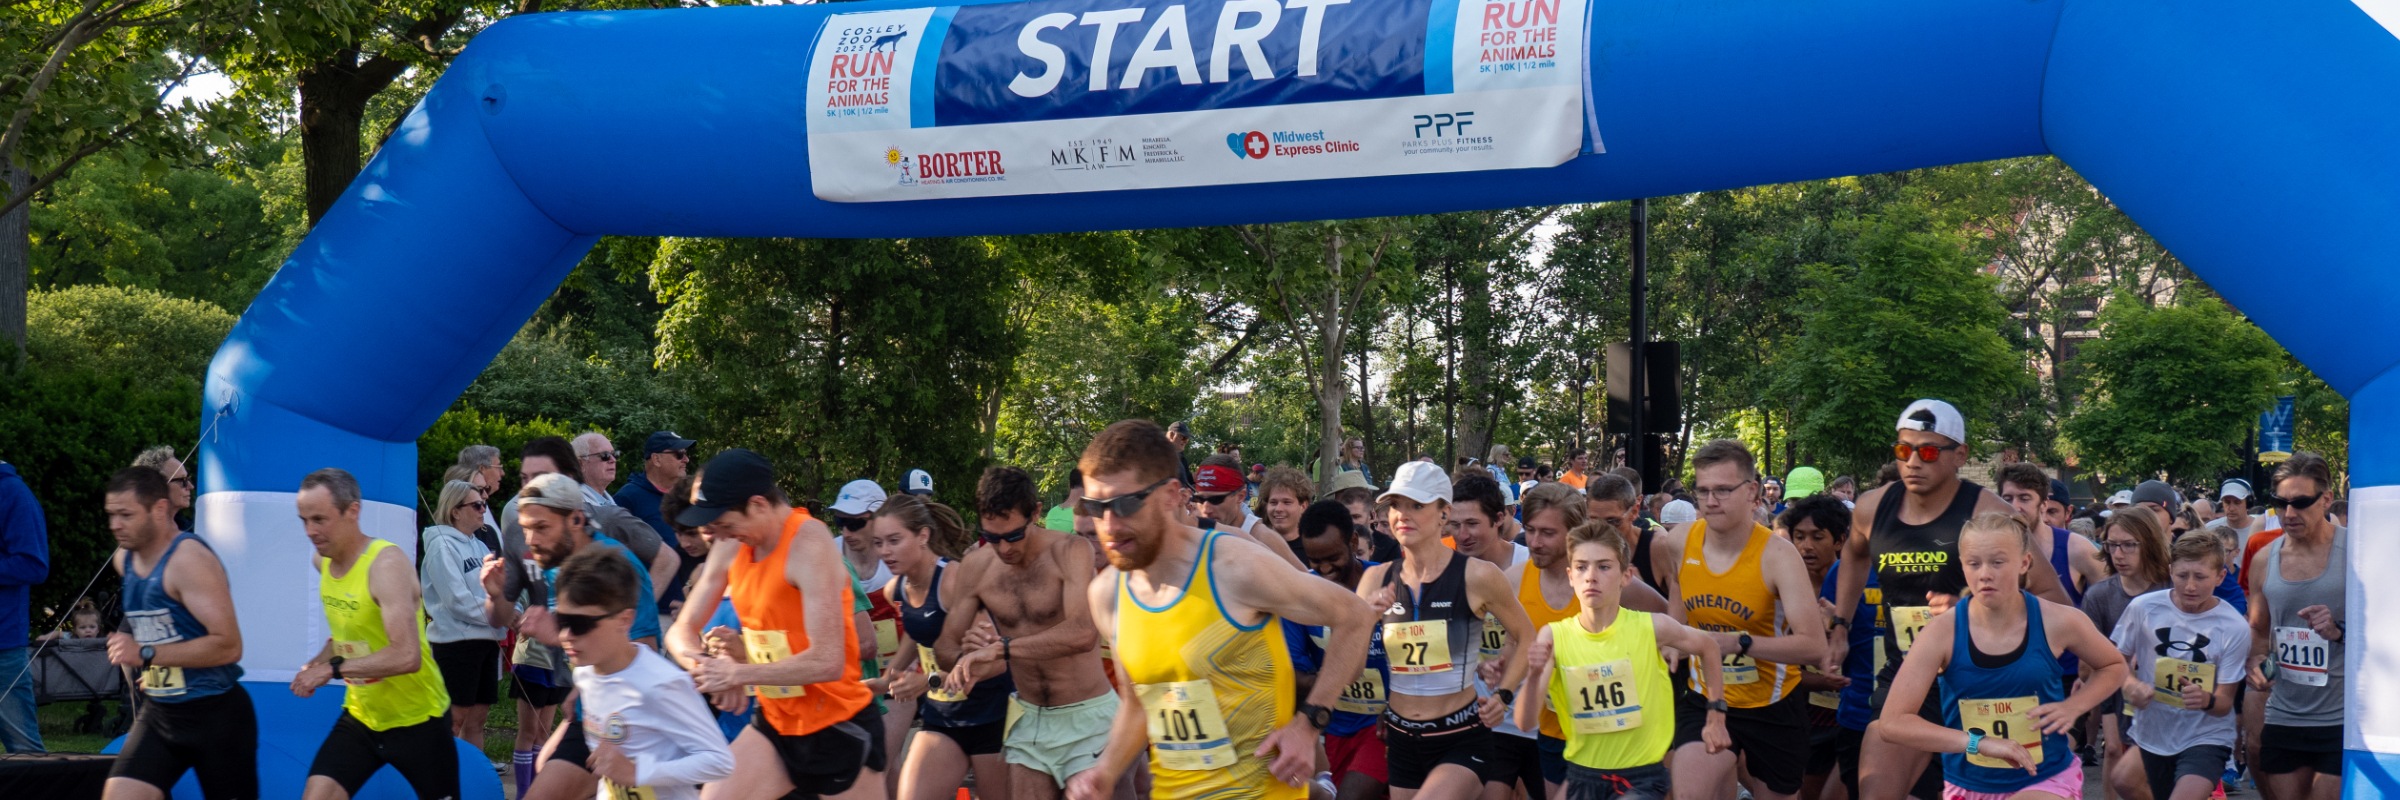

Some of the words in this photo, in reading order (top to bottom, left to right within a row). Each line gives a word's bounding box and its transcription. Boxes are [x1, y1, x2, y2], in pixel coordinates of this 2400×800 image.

[1482, 0, 1560, 30] RUN
[843, 24, 905, 36] COSLEY
[1481, 30, 1516, 46] FOR
[1523, 27, 1556, 43] THE
[838, 35, 873, 45] ZOO
[835, 45, 864, 53] 2025
[1008, 0, 1351, 98] START
[1480, 43, 1555, 63] ANIMALS
[830, 51, 895, 79] RUN
[1480, 64, 1490, 72] 5K
[1500, 63, 1515, 71] 10K
[1523, 61, 1536, 69] 1/2
[1539, 60, 1555, 68] mile
[828, 79, 857, 93] FOR
[862, 77, 890, 91] THE
[827, 92, 888, 108] ANIMALS
[827, 109, 836, 117] 5K
[843, 108, 856, 116] 10K
[862, 107, 873, 115] 1/2
[874, 106, 889, 114] mile
[1413, 111, 1474, 138] PPF
[1272, 129, 1325, 143] Midwest
[1402, 140, 1428, 148] PARKS
[1431, 138, 1453, 146] PLUS
[1456, 136, 1493, 144] FITNESS
[1275, 143, 1322, 158] Express
[1325, 140, 1359, 153] Clinic
[917, 150, 1005, 178] BORTER
[2264, 404, 2291, 428] W
[1888, 552, 1914, 564] DICK
[1916, 551, 1948, 563] POND
[1896, 565, 1939, 573] RACING
[1684, 594, 1755, 621] WHEATON
[1409, 625, 1425, 637] 10K
[1481, 630, 1506, 649] 10
[2297, 631, 2309, 640] 10K
[1402, 642, 1428, 665] 27
[2280, 643, 2324, 667] 2110
[1600, 665, 1613, 677] 5K
[2188, 664, 2198, 673] 5K
[1579, 681, 1625, 711] 146
[1993, 702, 2012, 714] 10K
[1159, 708, 1208, 741] 101
[1993, 720, 2009, 740] 9
